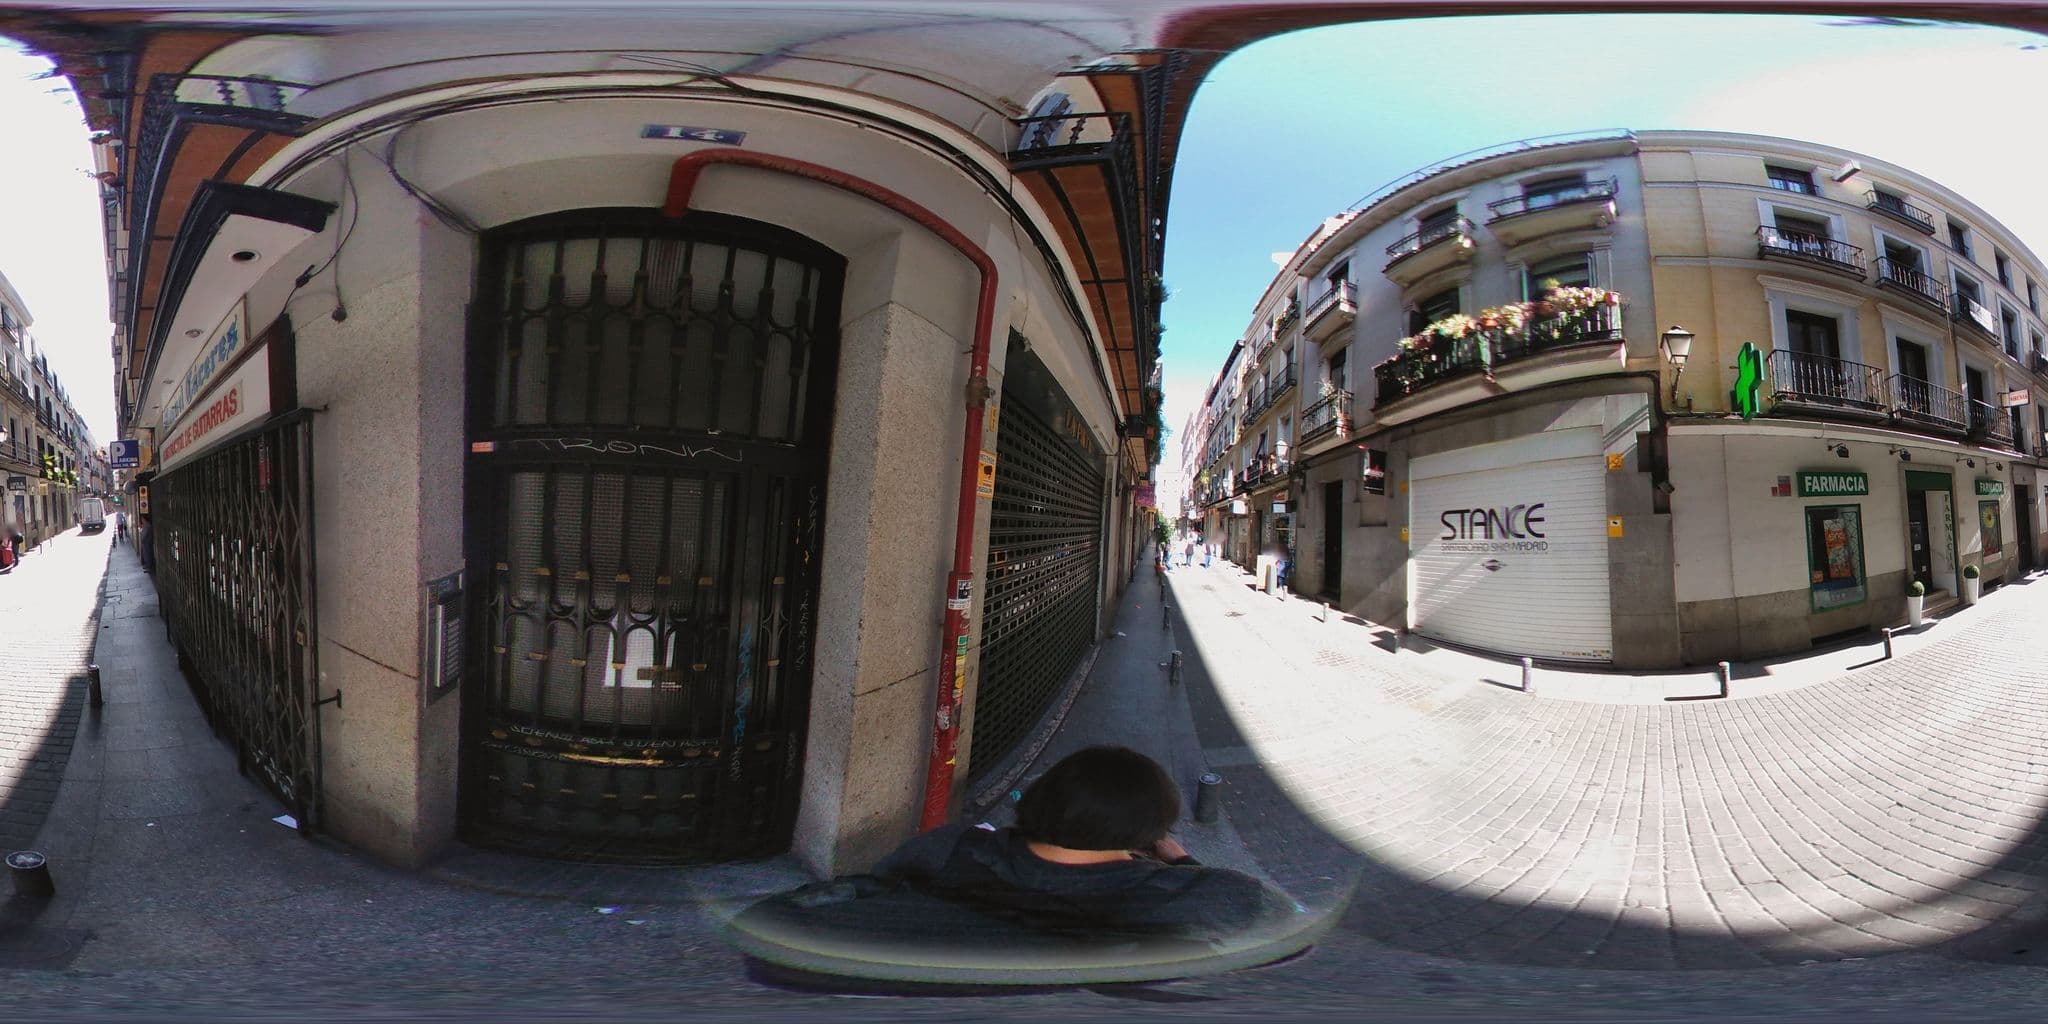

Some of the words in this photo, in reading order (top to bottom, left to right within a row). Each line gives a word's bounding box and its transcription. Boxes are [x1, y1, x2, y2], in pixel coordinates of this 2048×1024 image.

[664, 127, 724, 140] 14
[192, 387, 238, 440] GUITARRAS
[1804, 475, 1866, 493] FARMACIA
[1979, 481, 2003, 493] FARMACIA
[1441, 503, 1545, 540] STANCE
[1944, 494, 1955, 571] FARMACIA
[1516, 541, 1549, 551] MADRID
